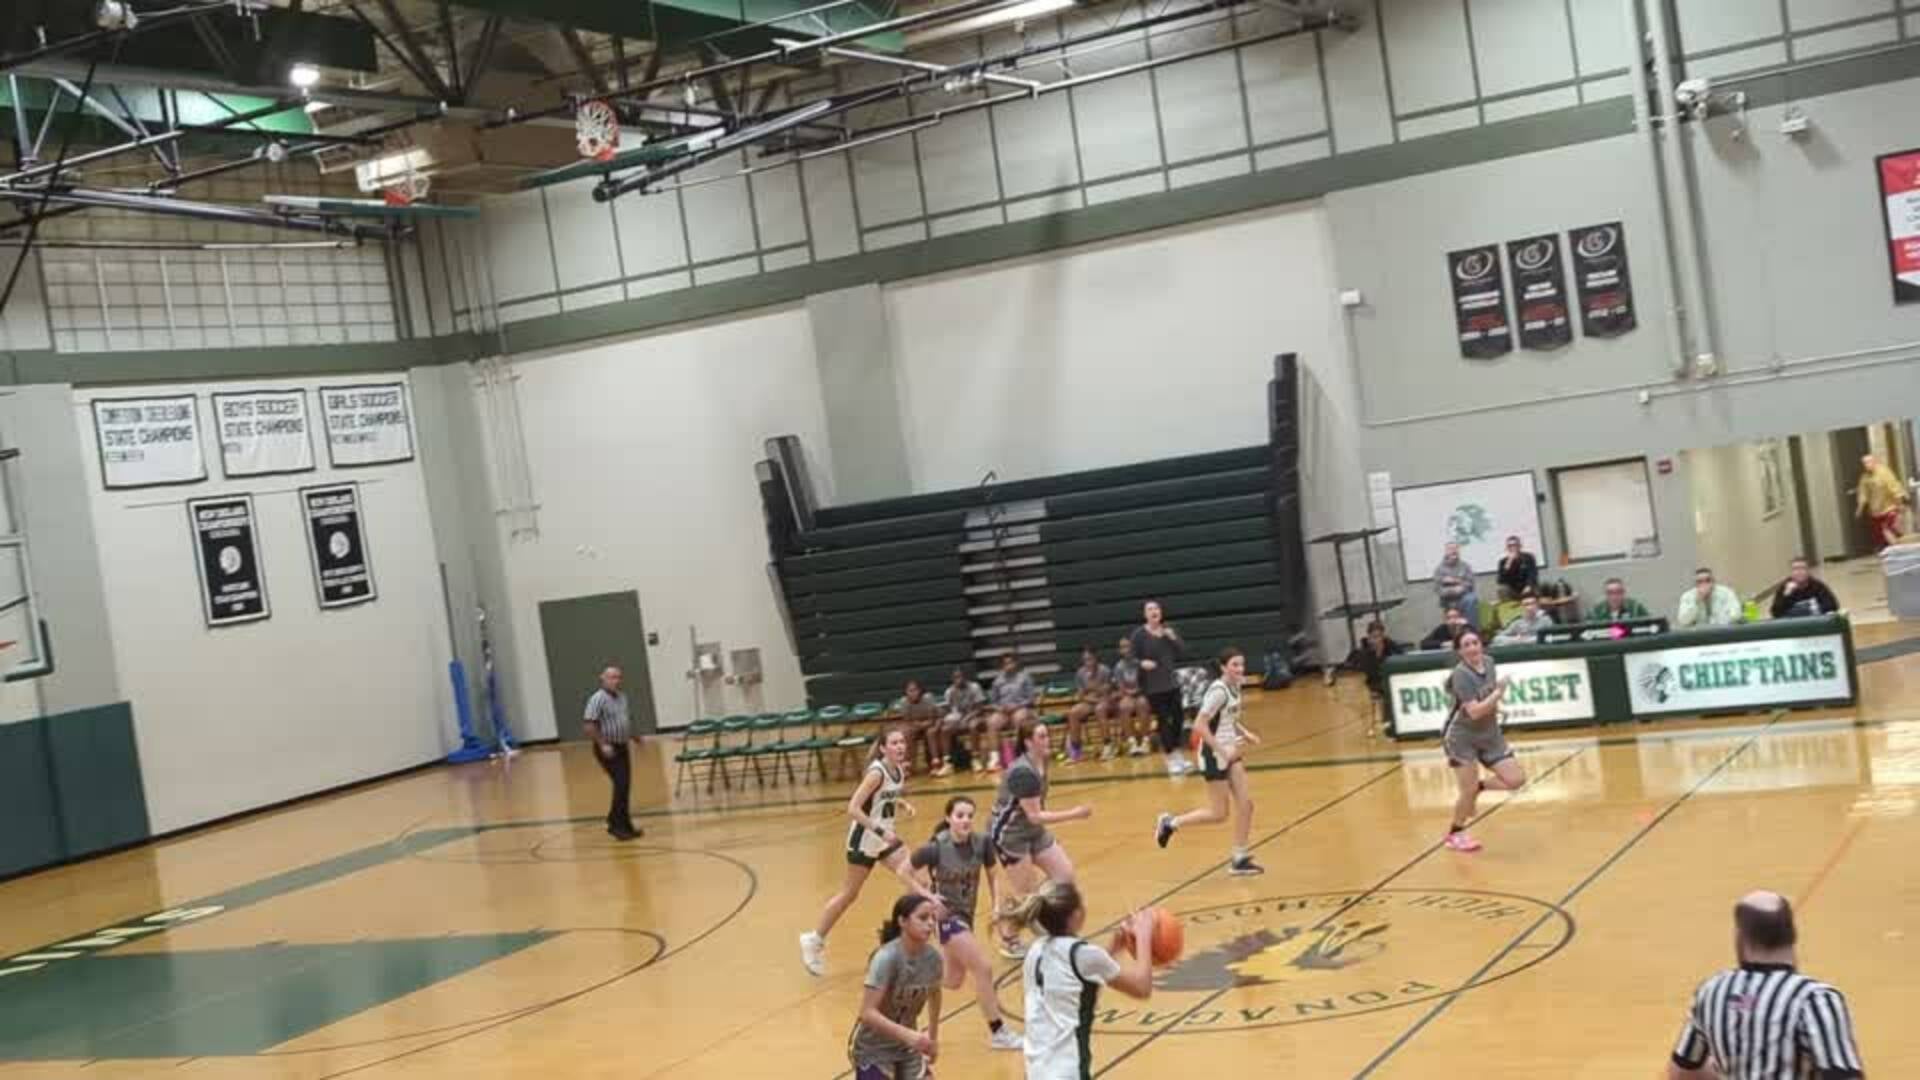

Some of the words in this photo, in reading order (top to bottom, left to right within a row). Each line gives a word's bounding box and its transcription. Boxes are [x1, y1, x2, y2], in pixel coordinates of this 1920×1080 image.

[256, 399, 298, 415] SOCCER
[1678, 651, 1837, 691] CHIEFTAINS
[1398, 672, 1582, 715] PONNSET
[1189, 893, 1388, 925] SCHOO
